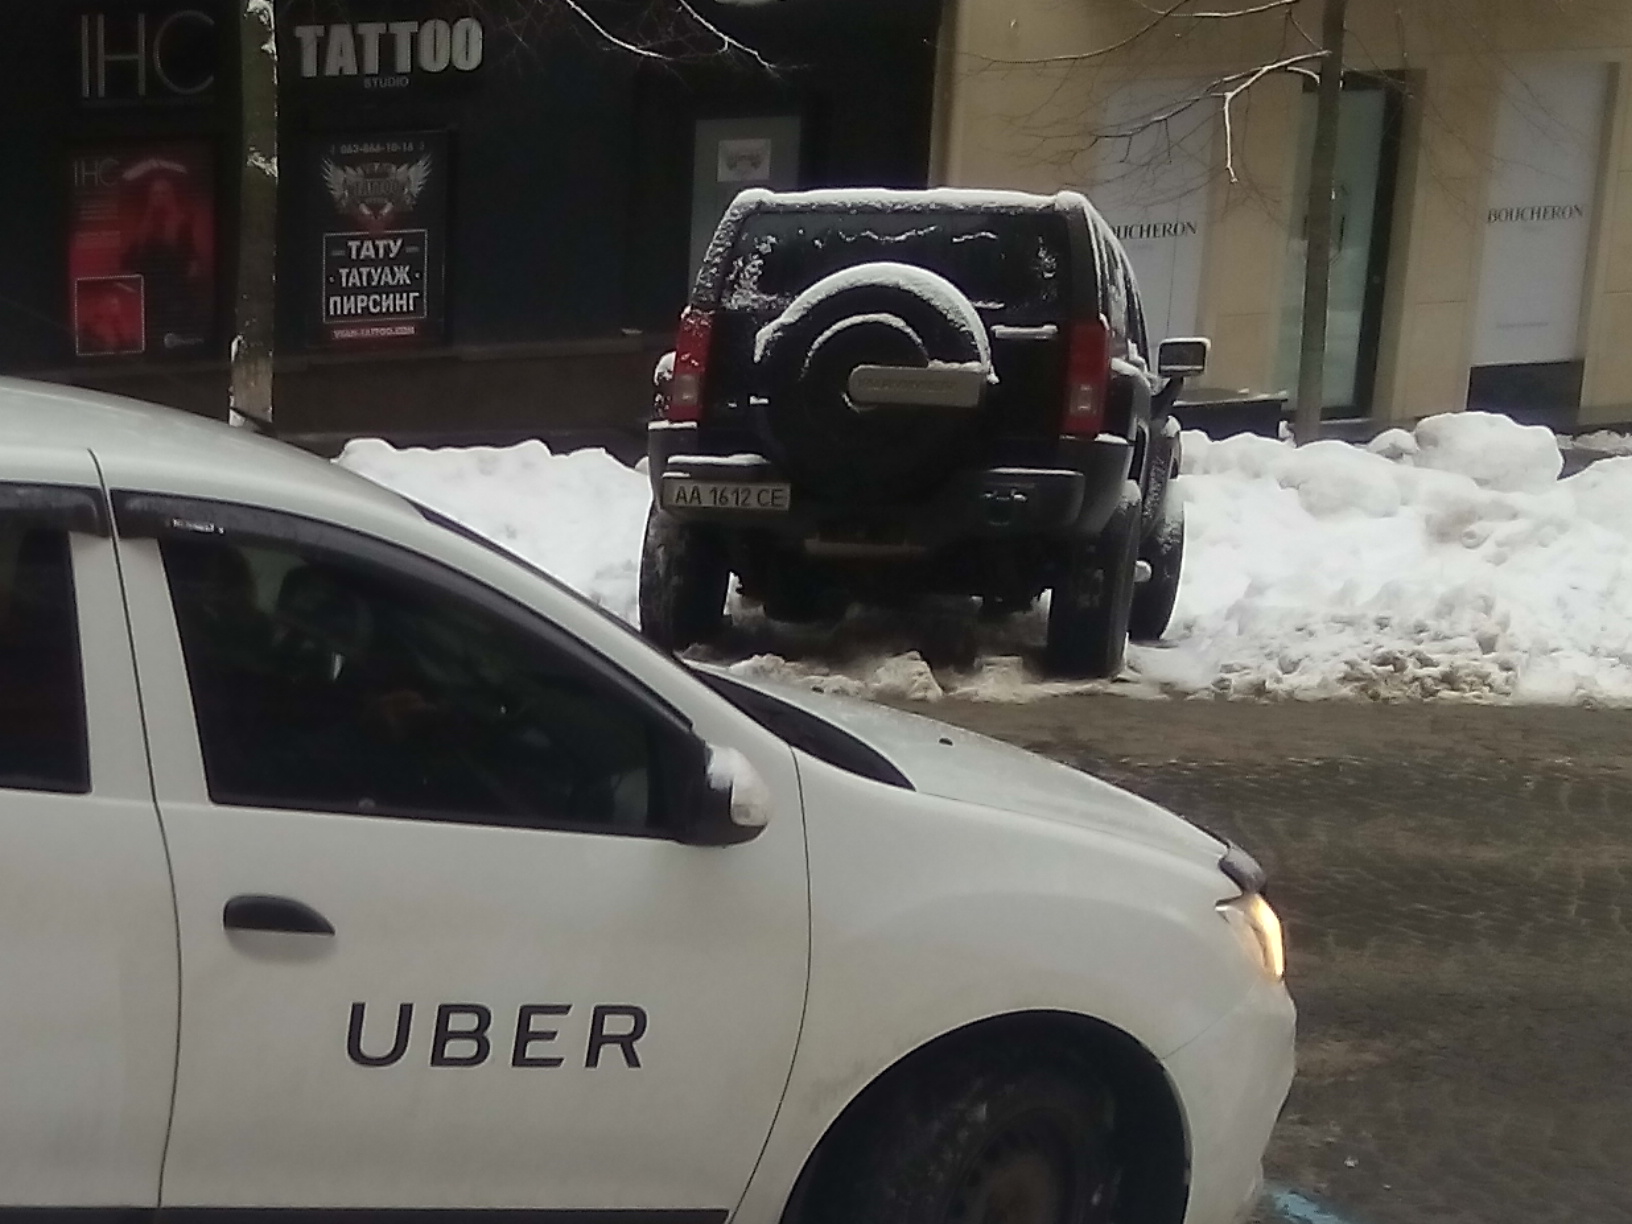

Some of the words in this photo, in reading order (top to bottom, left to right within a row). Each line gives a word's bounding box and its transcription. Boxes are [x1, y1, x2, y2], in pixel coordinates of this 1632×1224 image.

[81, 9, 215, 98] IHC
[294, 17, 483, 78] TATTOO
[363, 75, 410, 89] STUDIO
[1487, 204, 1584, 224] BOUCHERON
[347, 237, 404, 260] ТАТУ
[338, 264, 412, 288] ТАТУАЖ
[329, 292, 420, 316] ПИРСИНГ
[675, 485, 702, 505] AA
[709, 486, 752, 506] 1612
[756, 488, 785, 508] CE
[347, 1001, 648, 1069] UBER
